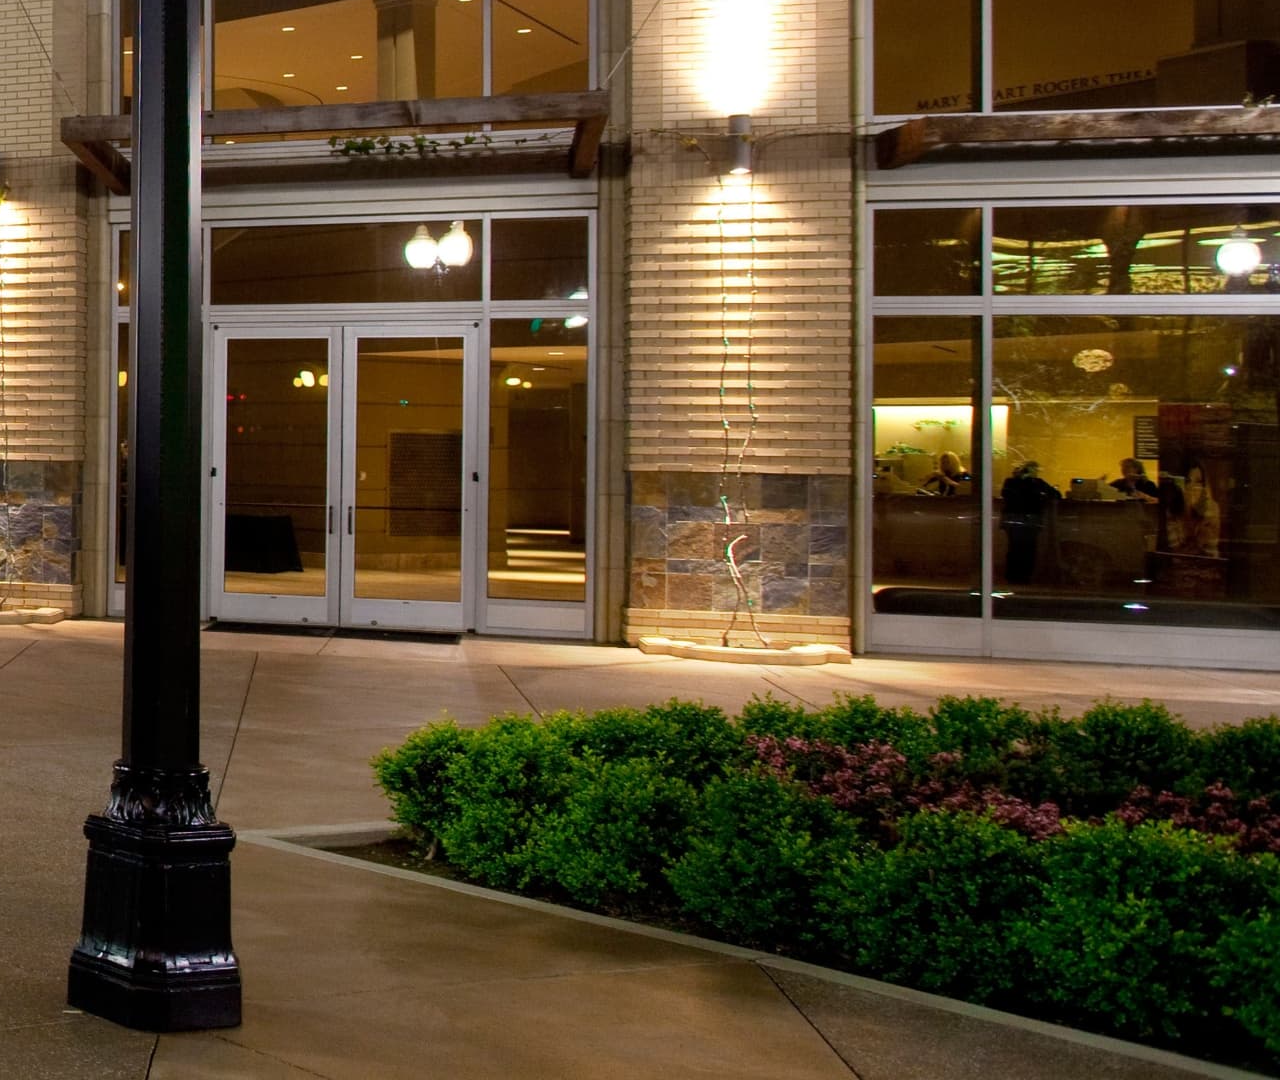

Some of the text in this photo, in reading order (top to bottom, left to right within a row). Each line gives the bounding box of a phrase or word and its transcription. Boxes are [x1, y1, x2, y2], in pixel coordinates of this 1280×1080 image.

[915, 94, 961, 111] MARY
[966, 85, 1027, 105] SART
[1033, 74, 1100, 95] ROGERS
